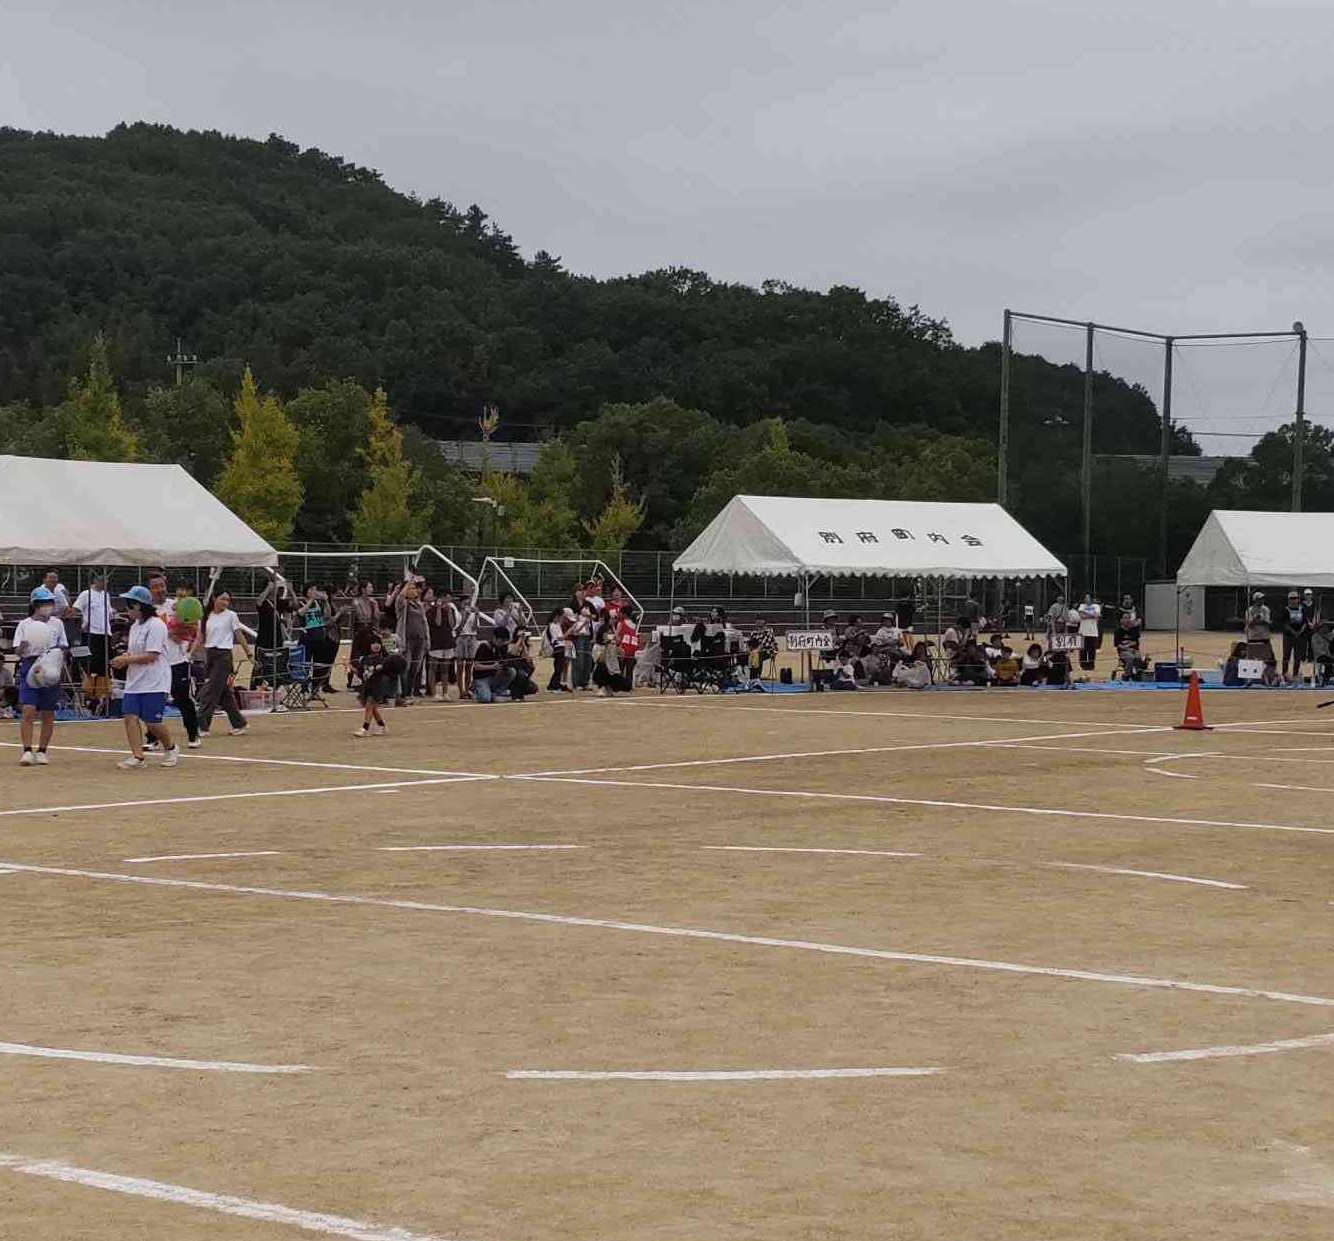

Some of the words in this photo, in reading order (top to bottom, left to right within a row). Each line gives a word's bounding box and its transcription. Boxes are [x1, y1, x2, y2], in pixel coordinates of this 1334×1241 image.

[818, 528, 984, 547] 別府町内会
